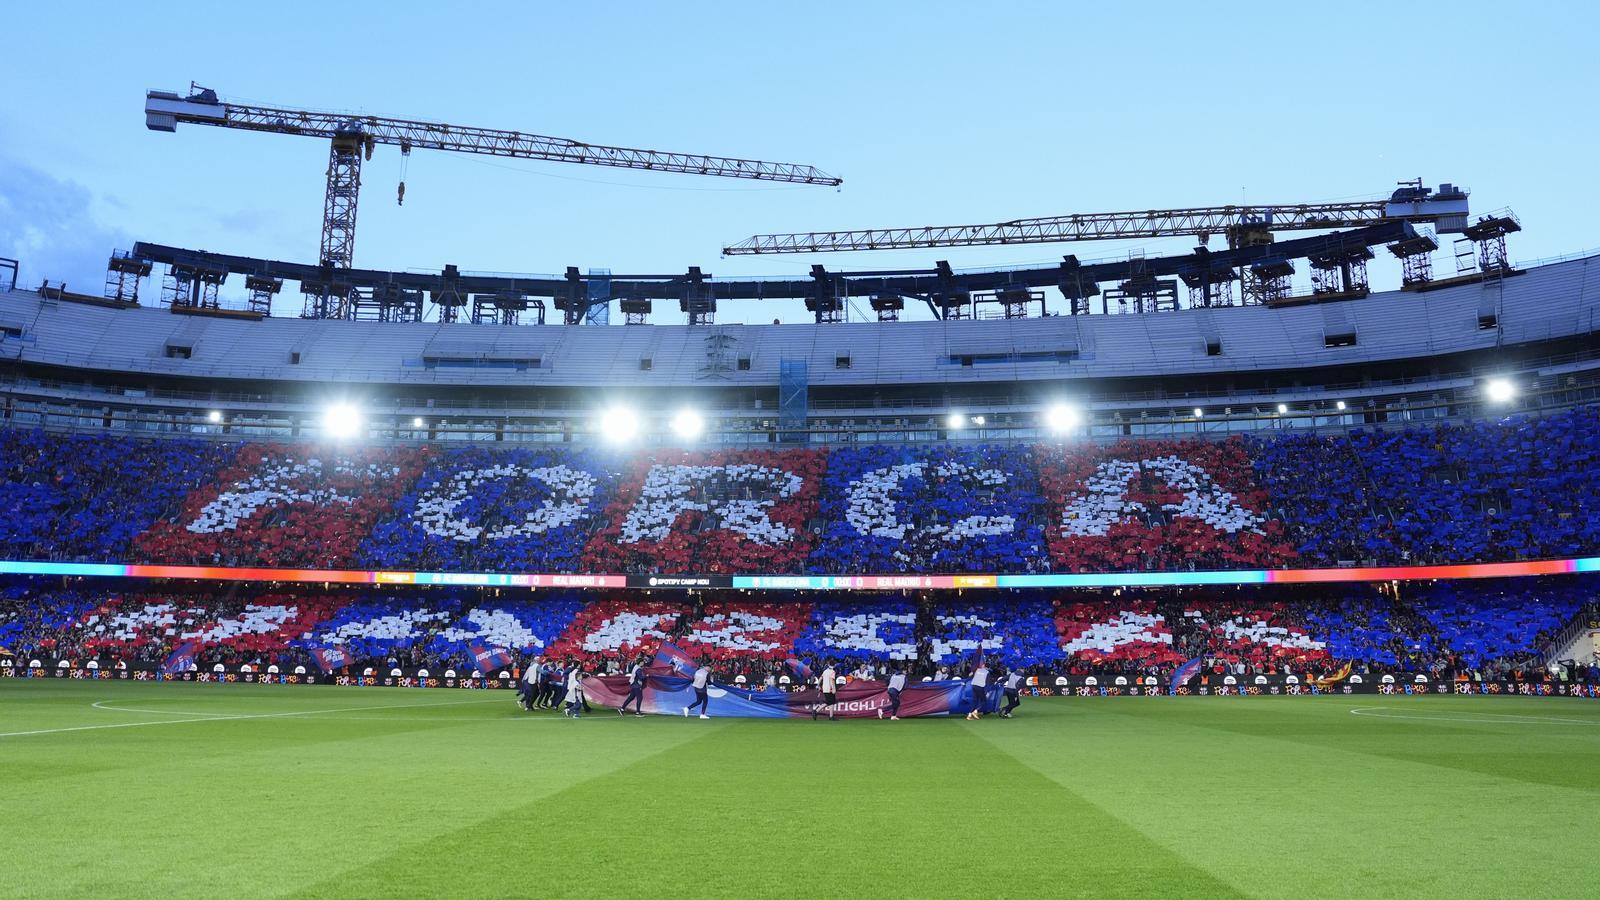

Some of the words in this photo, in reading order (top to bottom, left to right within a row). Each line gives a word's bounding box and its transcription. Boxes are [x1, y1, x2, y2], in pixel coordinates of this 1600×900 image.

[552, 576, 568, 586] REAL
[569, 576, 595, 586] MADRID
[877, 577, 893, 587] REAL
[894, 577, 921, 587] MADRID
